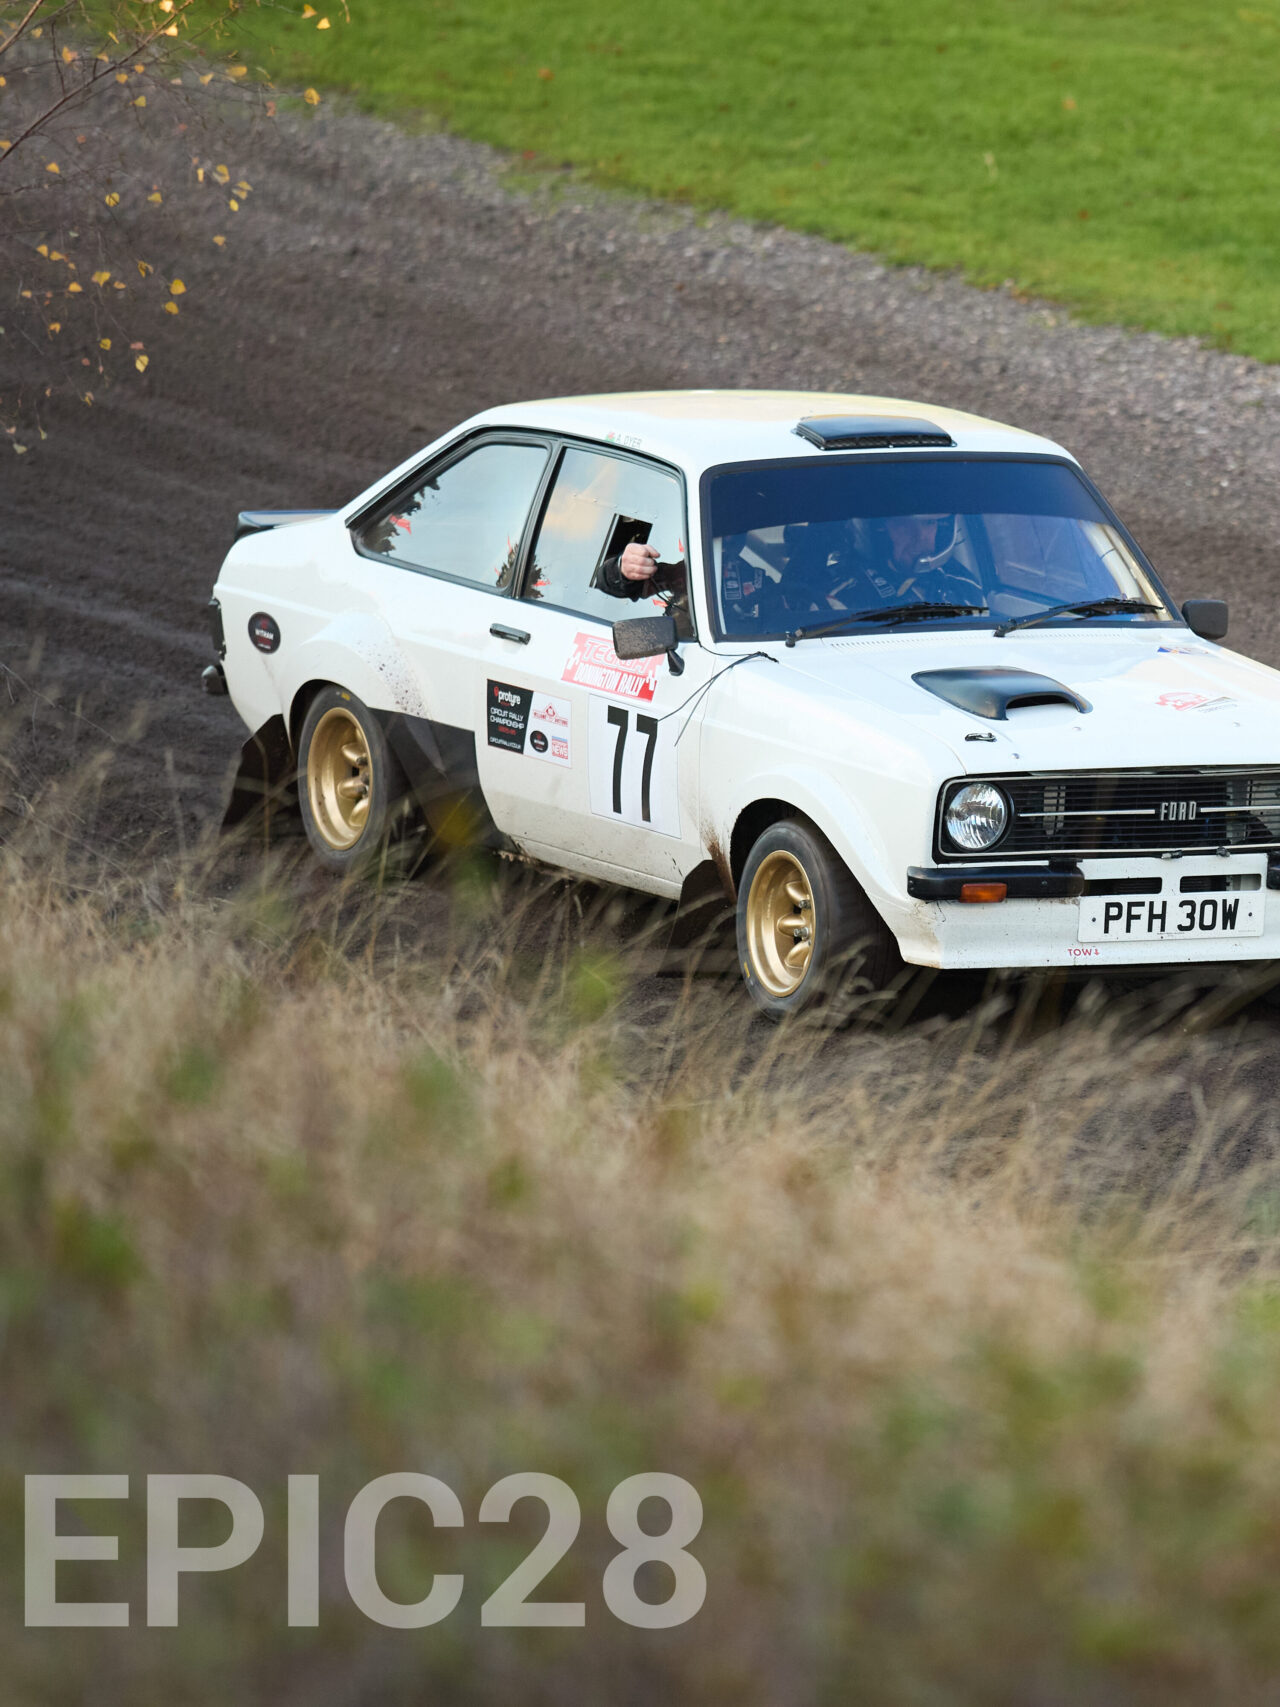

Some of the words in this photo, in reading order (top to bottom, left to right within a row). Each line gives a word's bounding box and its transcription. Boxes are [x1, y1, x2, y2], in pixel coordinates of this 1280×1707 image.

[574, 662, 621, 690] DONINGTON
[618, 673, 645, 696] RALLY
[498, 690, 521, 706] protyre
[490, 707, 508, 718] CIRCUIT
[508, 711, 524, 722] RALLY
[490, 715, 525, 730] CHAMPIONSHIP
[607, 704, 659, 823] 77
[1160, 800, 1197, 821] FORD
[1104, 901, 1168, 934] PFH
[1177, 898, 1239, 932] 30W
[1067, 948, 1092, 957] TOW
